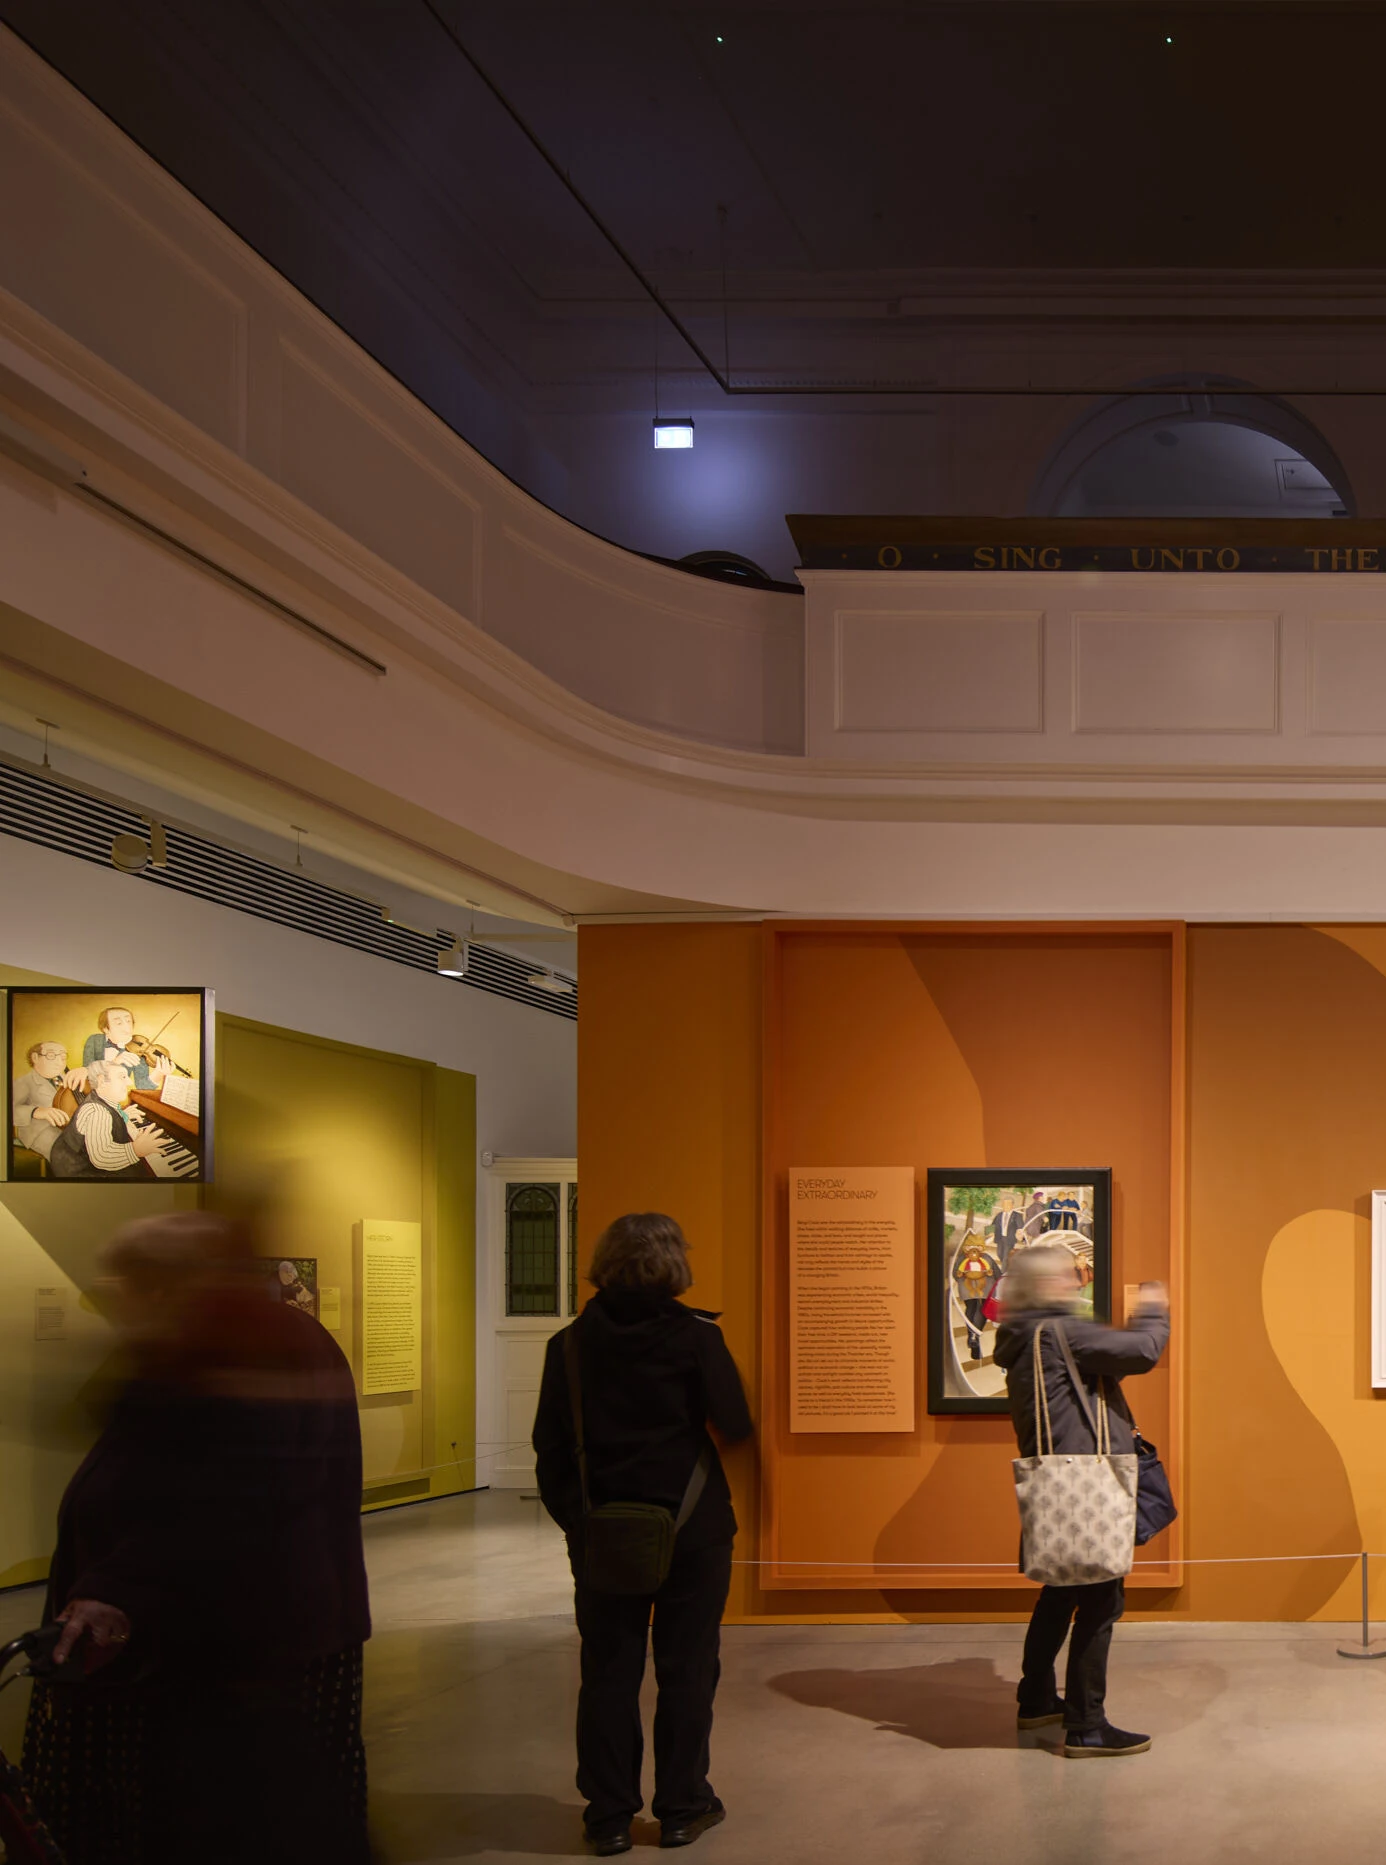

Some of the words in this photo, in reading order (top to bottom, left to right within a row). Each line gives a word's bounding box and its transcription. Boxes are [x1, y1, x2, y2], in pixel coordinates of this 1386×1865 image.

[877, 545, 903, 569] O
[973, 546, 1062, 569] SING
[1131, 547, 1241, 570] UNTO
[1305, 548, 1380, 571] THE
[797, 1179, 846, 1189] EVERYDAY
[797, 1190, 879, 1200] EXTRAORDINARY
